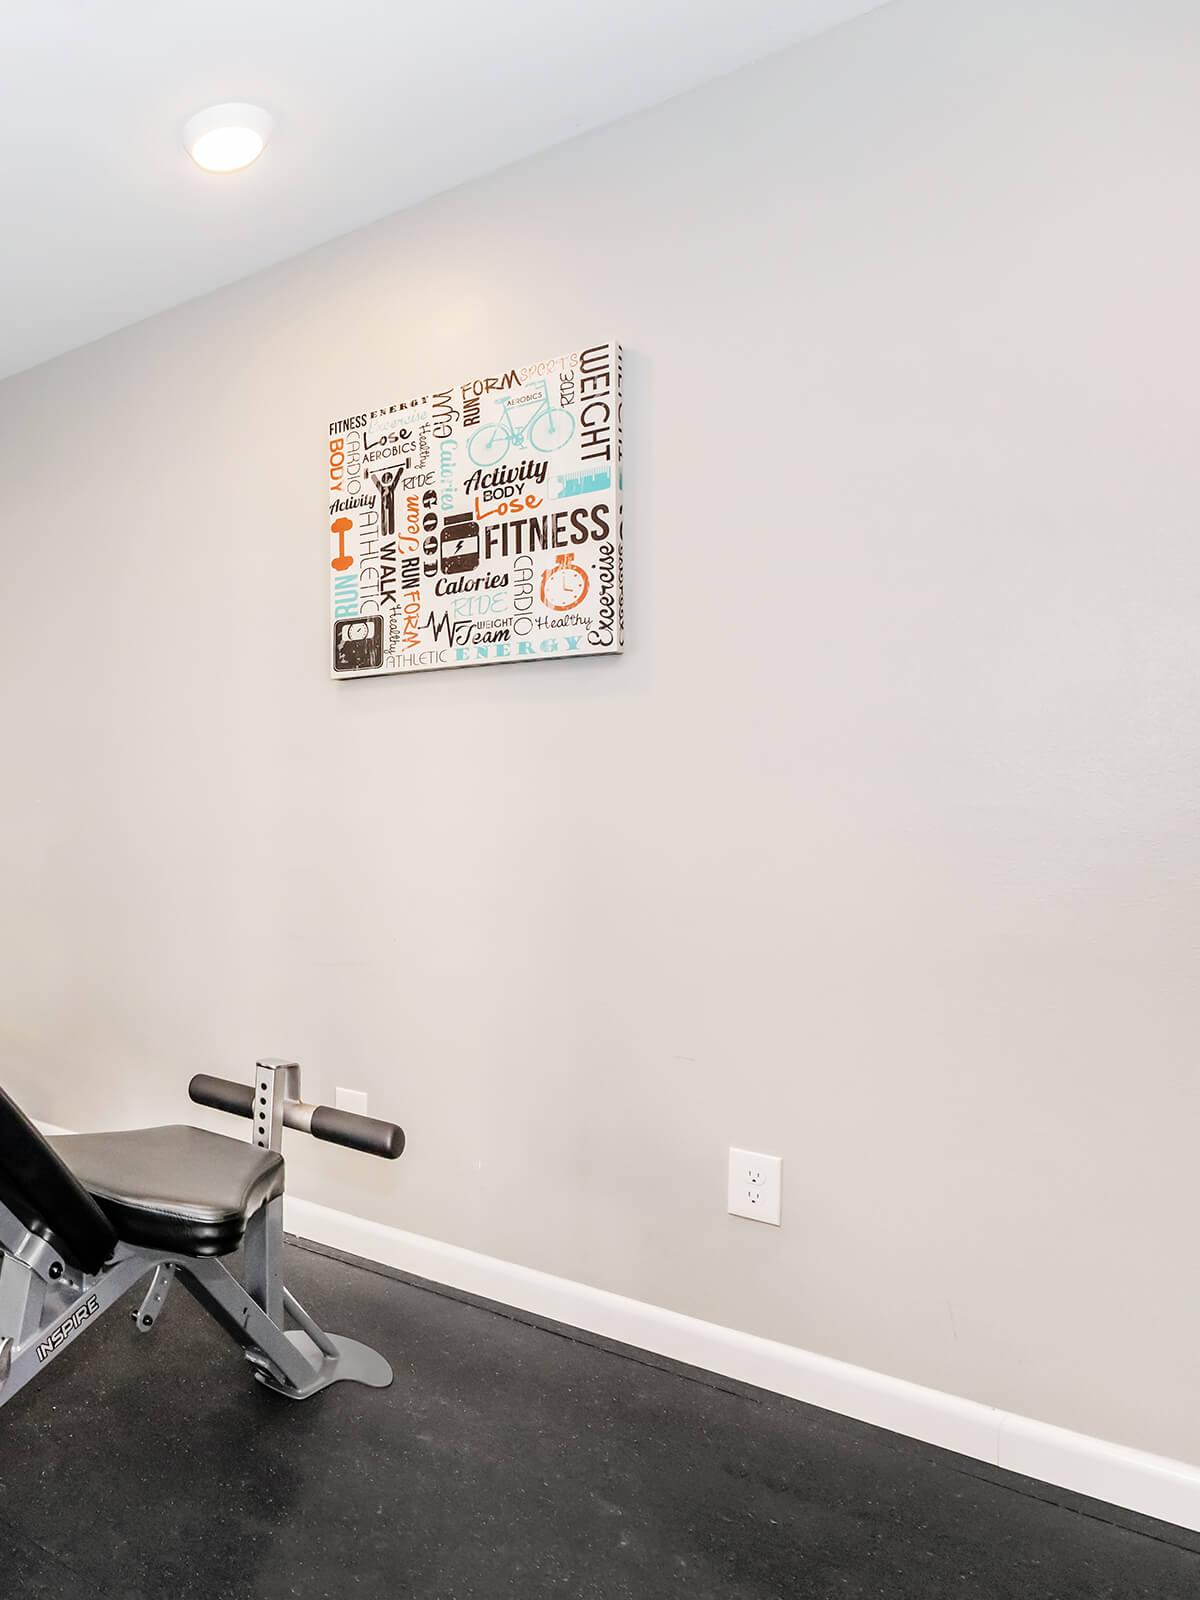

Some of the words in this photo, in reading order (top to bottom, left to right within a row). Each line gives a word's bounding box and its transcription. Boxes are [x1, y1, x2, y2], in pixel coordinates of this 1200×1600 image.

[461, 370, 521, 400] FORM
[506, 392, 543, 407] AEROBICS
[560, 369, 575, 408] RIDE
[463, 397, 481, 427] RUN
[580, 344, 611, 461] WEIGHT
[329, 413, 367, 436] FITNESS
[363, 428, 413, 451] Lose
[362, 440, 417, 464] AEROBICS
[414, 421, 431, 470] Healthy
[329, 438, 345, 491] BODY
[346, 431, 362, 495] CARDIO
[440, 438, 458, 512] Calories
[463, 459, 549, 495] Activity
[401, 471, 437, 491] RIDE
[483, 482, 525, 503] BODY
[328, 493, 377, 515] Activity
[474, 494, 544, 521] Lose
[398, 494, 420, 555] Team
[422, 489, 438, 577] GOOD
[485, 504, 610, 560] FITNESS
[359, 510, 380, 615] ATHLETIC
[379, 541, 398, 606] WALK
[401, 557, 420, 590] RUN
[334, 573, 359, 619] RUN
[435, 572, 510, 597] Calories
[513, 555, 534, 636] CARDIO
[401, 590, 422, 652] FORM
[452, 592, 508, 618] RIDE
[535, 612, 593, 631] Healthy
[384, 604, 401, 655] Healthy
[455, 622, 512, 646] Team
[476, 617, 514, 630] WEIGHT
[386, 649, 448, 669] ATHLETIC
[455, 635, 583, 662] ENERGY
[35, 1293, 100, 1363] INSPIRE
